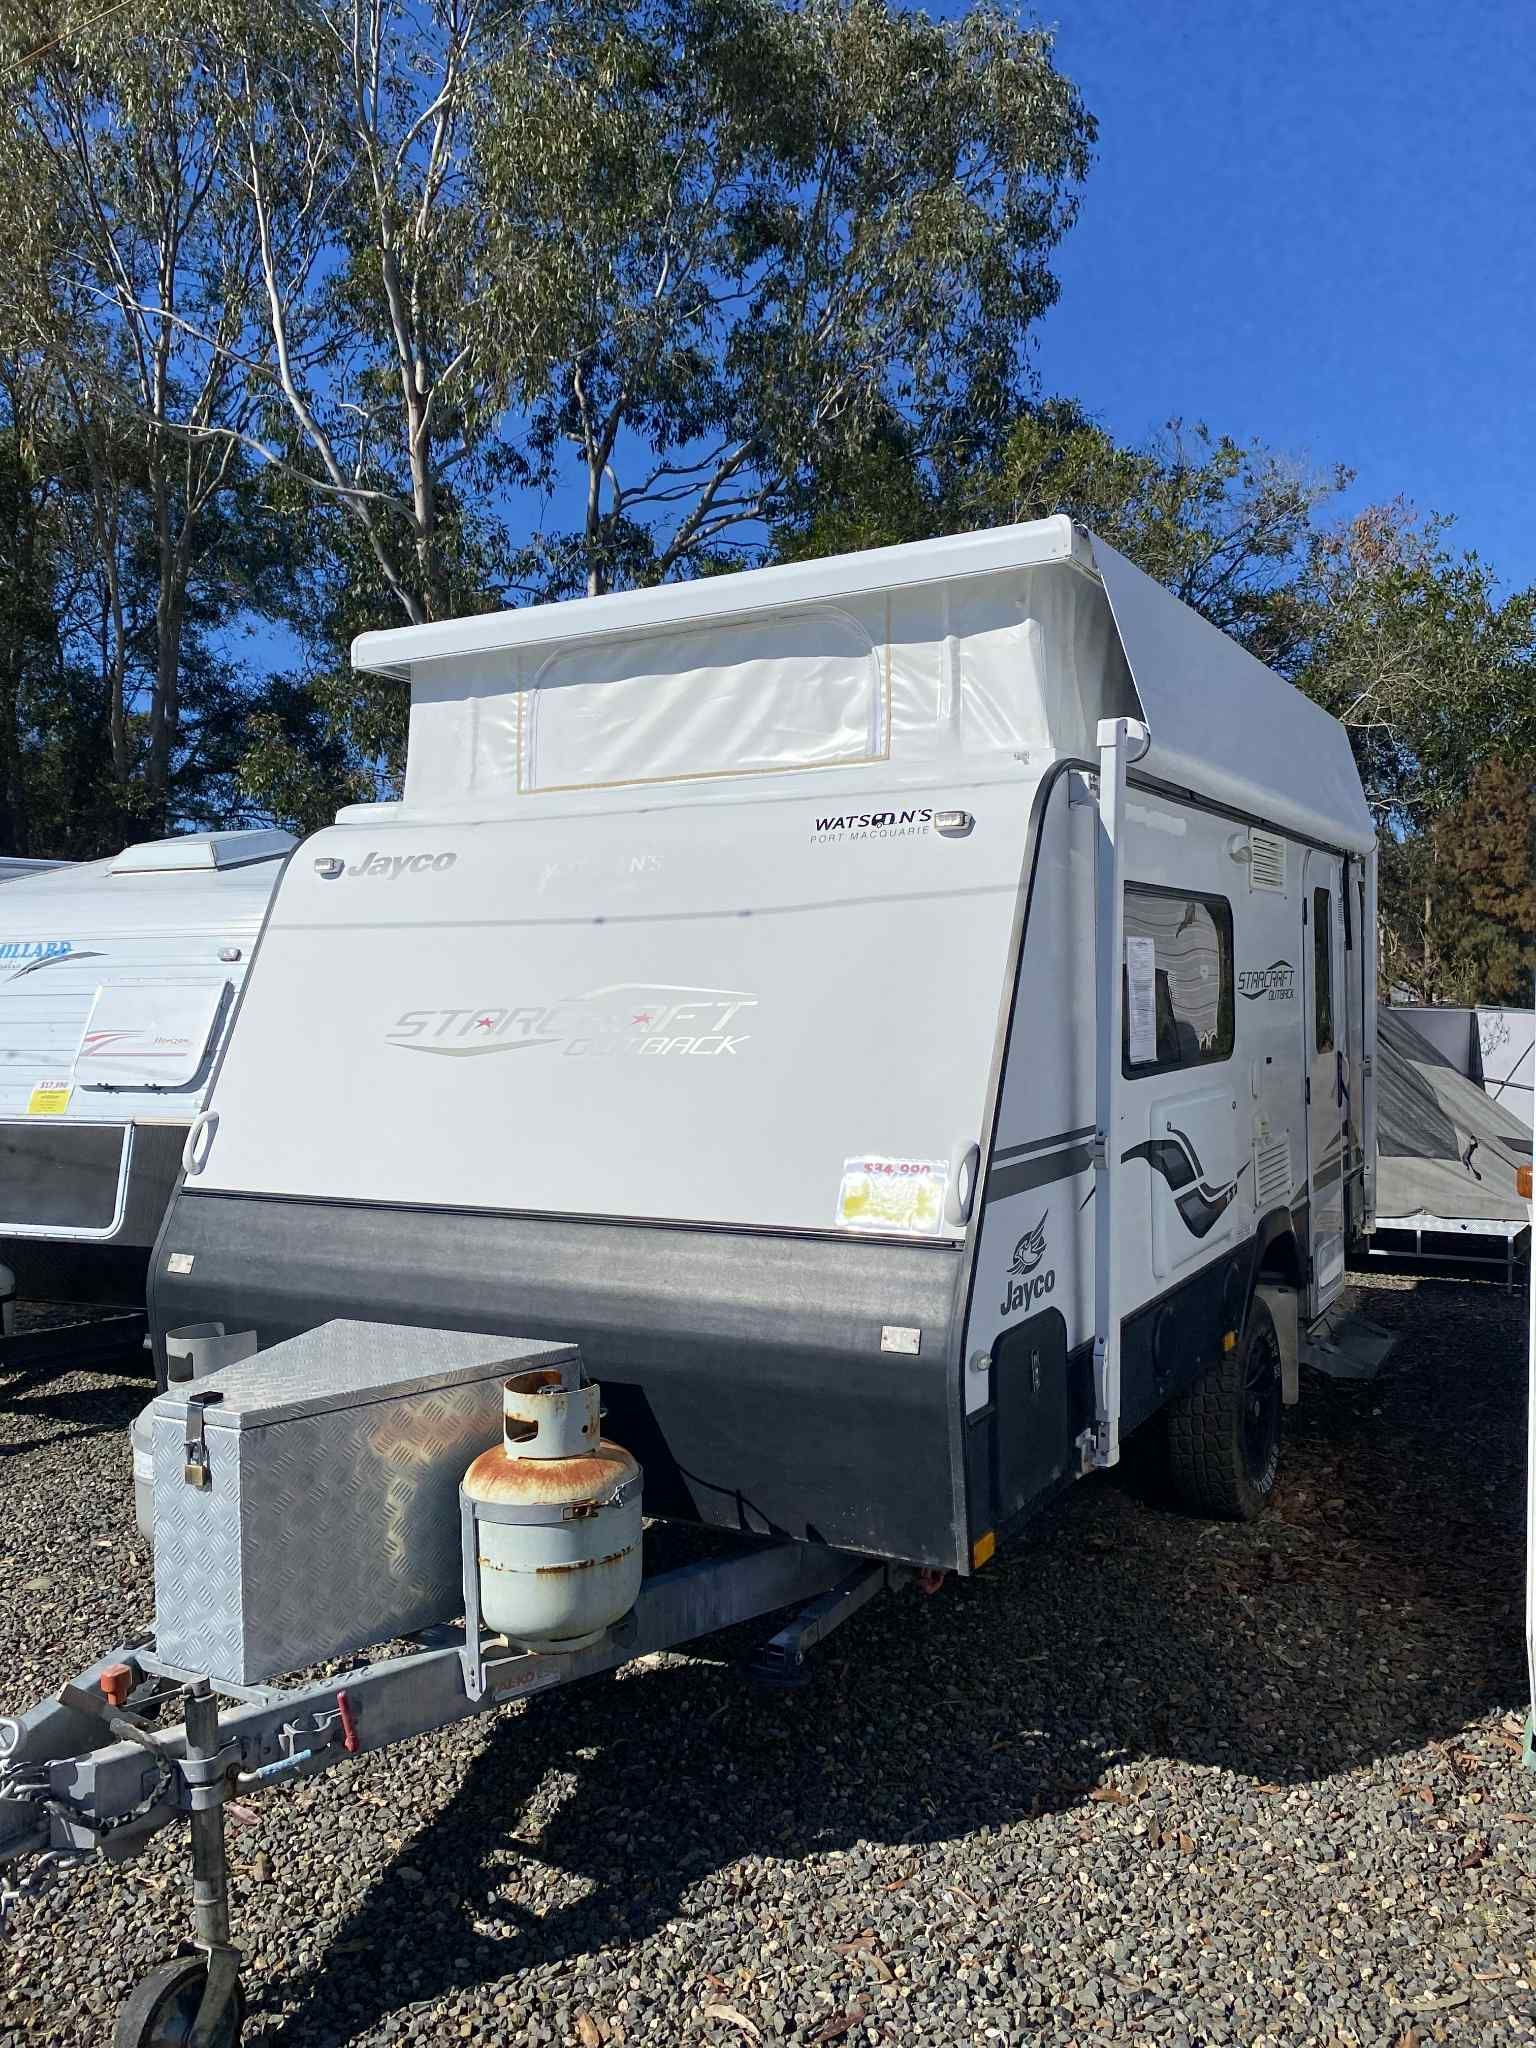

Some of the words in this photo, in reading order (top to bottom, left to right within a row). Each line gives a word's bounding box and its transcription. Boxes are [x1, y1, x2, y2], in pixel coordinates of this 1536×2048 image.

[815, 808, 933, 831] WATSON'S
[810, 834, 844, 844] PORT
[850, 826, 929, 841] MACQUARIE
[346, 851, 457, 880] Jayco
[1238, 970, 1295, 989] STARCRAFT
[384, 1000, 758, 1038] STARCAFT
[863, 1163, 931, 1177] $34,990
[1001, 1269, 1055, 1316] Jayco
